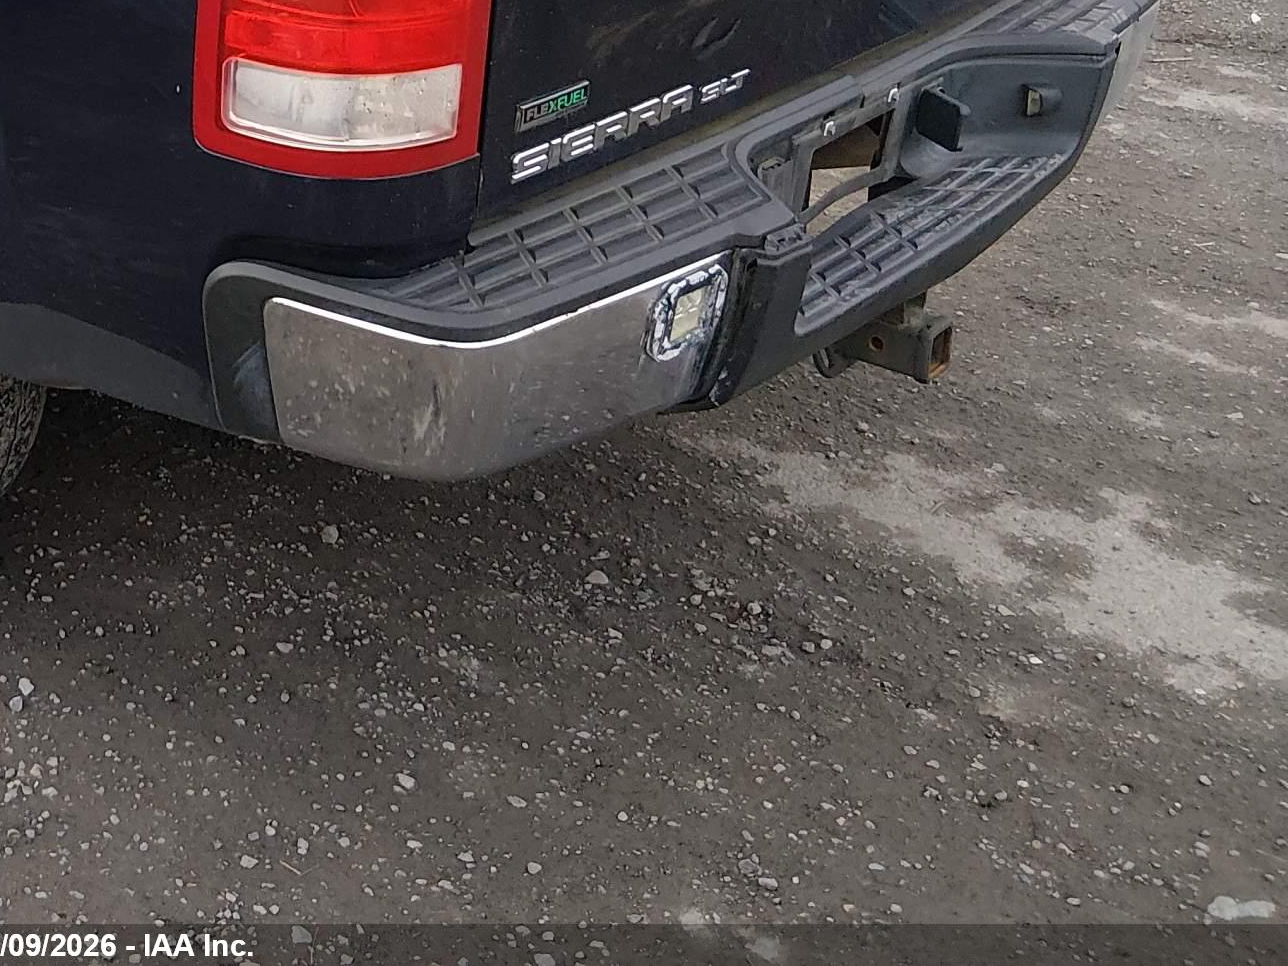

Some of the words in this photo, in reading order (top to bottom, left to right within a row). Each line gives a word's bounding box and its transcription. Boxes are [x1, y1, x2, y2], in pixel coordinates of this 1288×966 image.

[510, 84, 694, 184] SIERRA
[700, 68, 751, 104] SLT
[525, 88, 589, 123] FLEXFUEL
